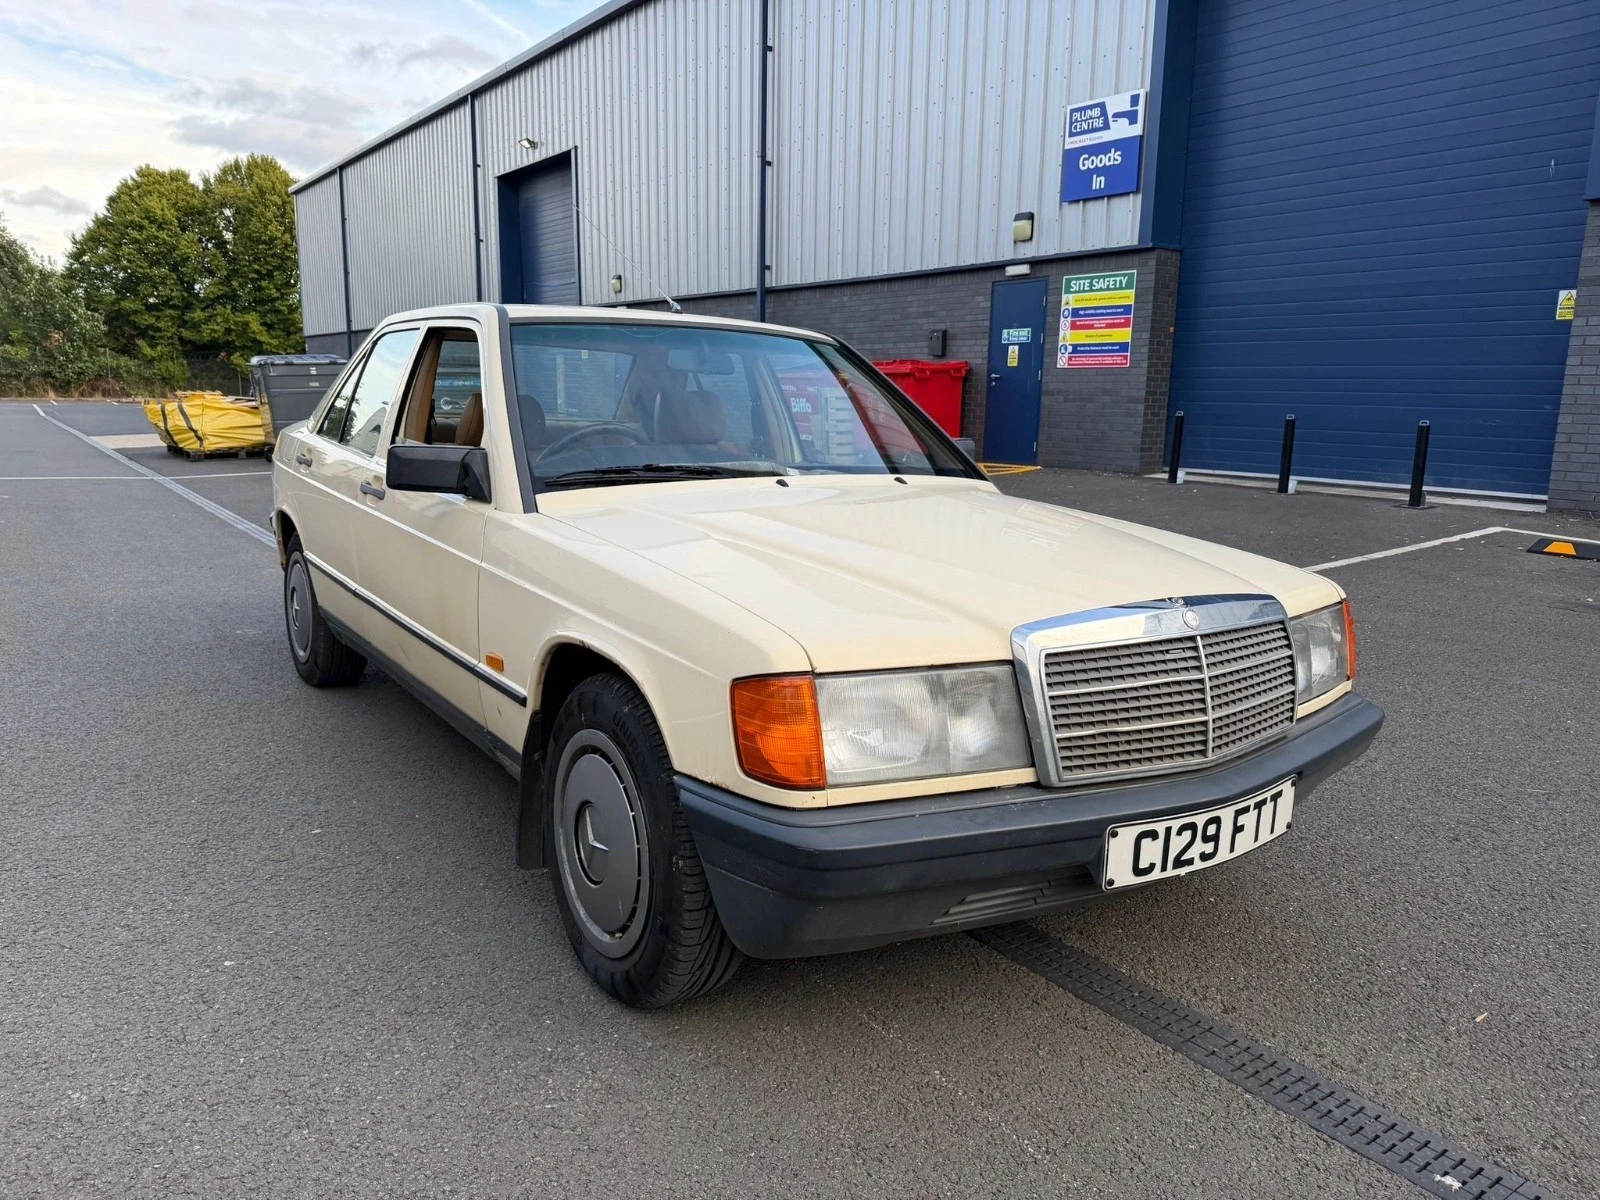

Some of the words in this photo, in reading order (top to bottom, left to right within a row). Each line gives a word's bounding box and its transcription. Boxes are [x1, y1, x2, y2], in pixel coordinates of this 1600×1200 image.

[1072, 107, 1101, 122] PLUMB
[1071, 117, 1105, 133] CENTRE
[1079, 147, 1122, 171] Goods
[1092, 174, 1105, 190] In
[1070, 279, 1090, 292] SITE
[1092, 276, 1128, 290] SAFETY
[790, 397, 812, 413] Biffa
[1132, 815, 1222, 877] C129
[1229, 789, 1283, 854] FTT
